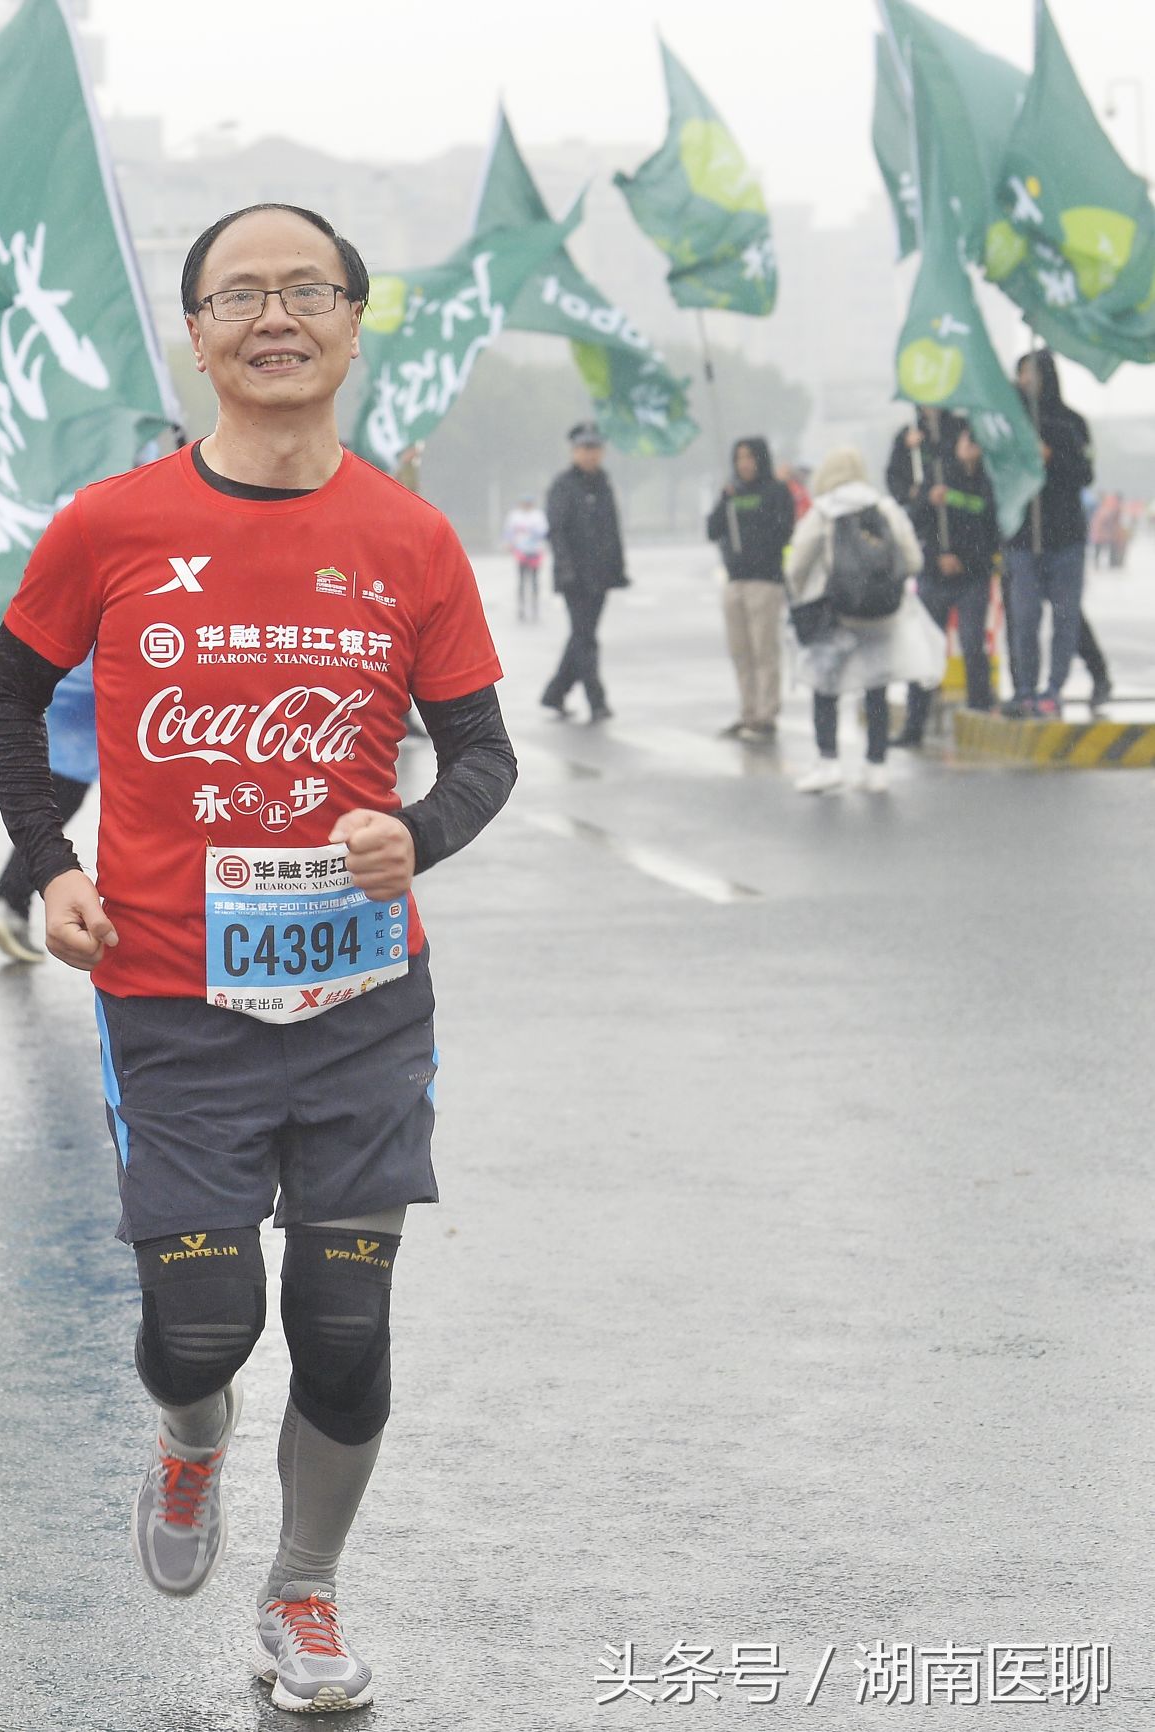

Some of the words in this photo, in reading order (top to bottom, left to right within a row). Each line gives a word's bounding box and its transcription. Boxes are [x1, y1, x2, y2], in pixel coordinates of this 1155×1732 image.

[196, 624, 392, 660] 华融湘江银行
[197, 653, 267, 664] HUARONG
[274, 653, 358, 668] XIANGJIANG
[361, 659, 390, 672] BANK
[137, 686, 374, 765] Coca-Cola
[255, 881, 307, 891] HUARONG
[311, 876, 354, 890] XIANGJI
[223, 916, 362, 977] C4394
[231, 998, 284, 1011] 智美出品
[160, 1246, 239, 1264] VANTELIN
[324, 1248, 391, 1268] VANTELIN
